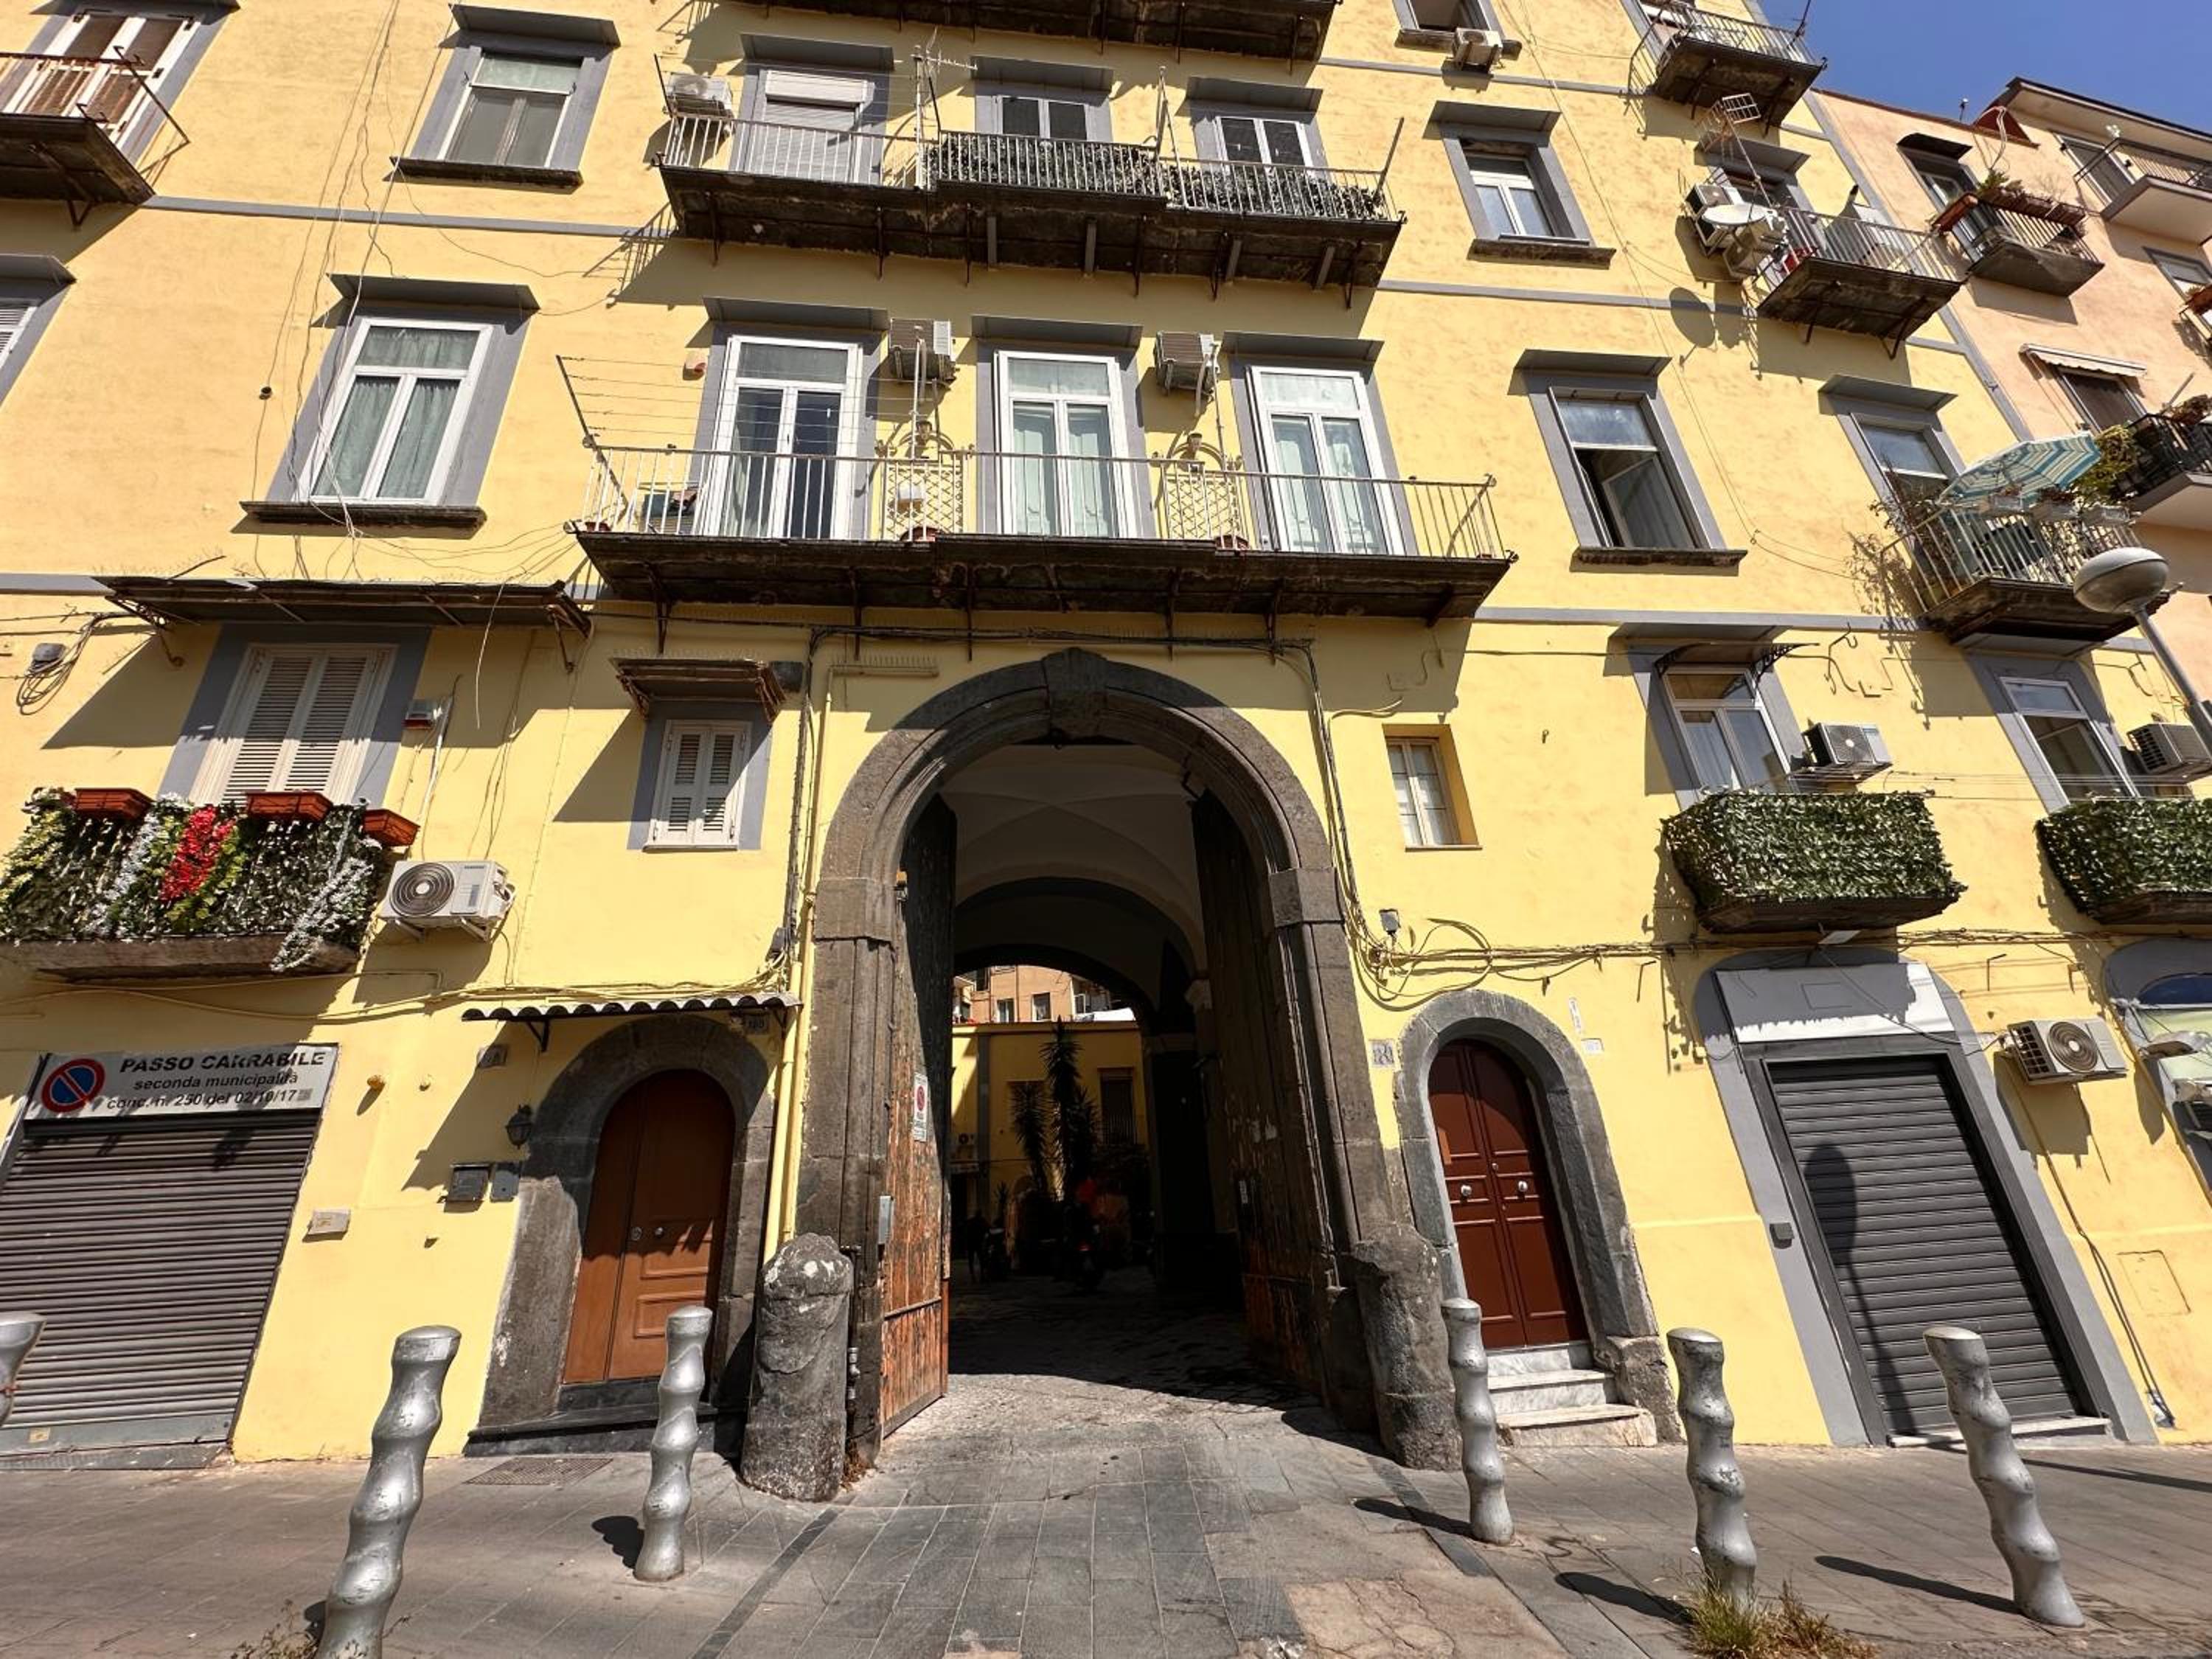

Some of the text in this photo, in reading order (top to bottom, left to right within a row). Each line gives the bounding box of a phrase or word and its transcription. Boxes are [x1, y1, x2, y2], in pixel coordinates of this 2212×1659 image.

[119, 1051, 326, 1073] PASSO CARRABILE
[133, 1073, 299, 1091] seconda municipalità
[107, 1098, 150, 1110] conc.
[174, 1093, 202, 1106] 250
[206, 1091, 230, 1105] del
